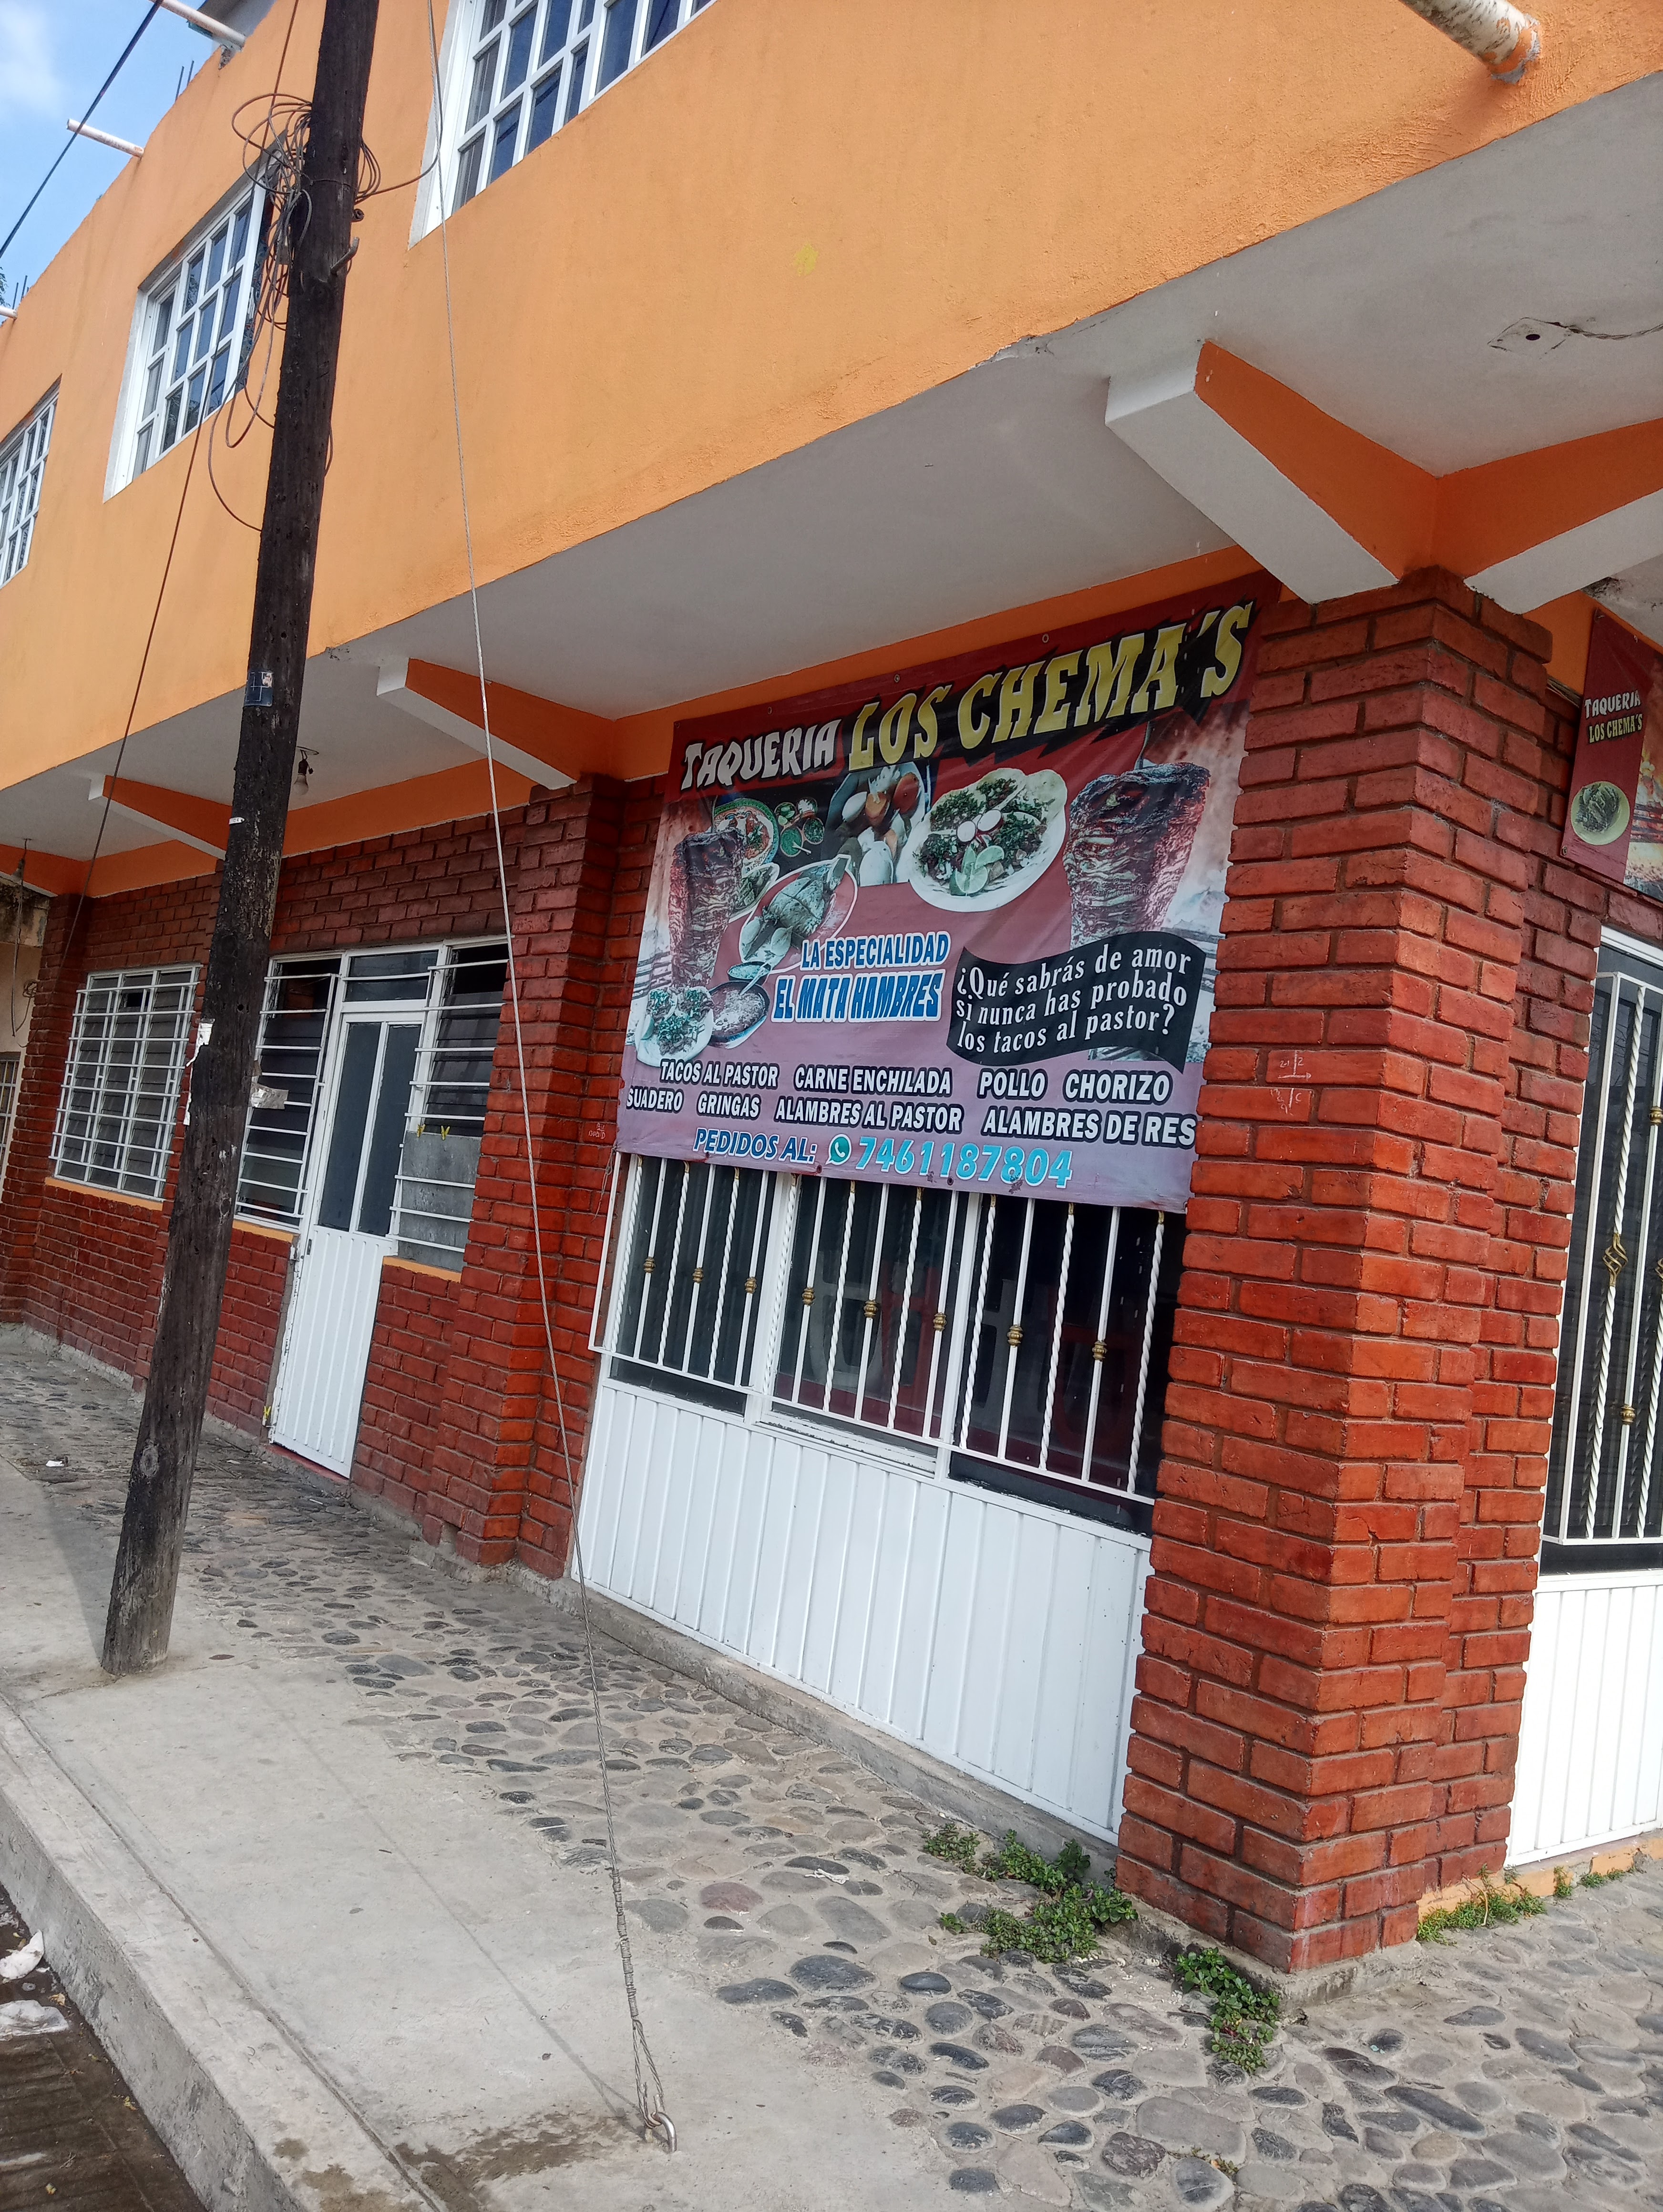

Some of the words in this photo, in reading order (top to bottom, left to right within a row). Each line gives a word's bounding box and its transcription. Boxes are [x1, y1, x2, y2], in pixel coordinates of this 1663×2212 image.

[1584, 690, 1641, 719] TAQUERIA
[680, 718, 842, 791] TAQUERIA
[848, 684, 953, 772] LOS
[1589, 723, 1605, 743] LOS
[801, 939, 821, 971] LA
[825, 932, 949, 970] ESPECIALIDAD
[957, 966, 1007, 999] ¿Qué
[1015, 955, 1085, 995] sabrás
[1095, 943, 1121, 974] de
[1131, 947, 1191, 975] amor
[771, 975, 795, 1022] EL
[797, 974, 848, 1022] MATA
[849, 970, 945, 1021] HAMBRES
[956, 995, 973, 1021] si
[977, 1003, 1036, 1025] nunca
[1044, 989, 1081, 1017] has
[1091, 971, 1187, 1010] probado
[957, 1022, 985, 1053] los
[994, 1027, 1047, 1054] tacos
[1056, 1010, 1077, 1041] al
[1085, 1003, 1175, 1041] pastor?
[661, 1061, 700, 1083] TACOS
[703, 1065, 720, 1084] AL
[724, 1064, 778, 1087] PASTOR
[795, 1067, 847, 1090] CARNE
[853, 1069, 951, 1094] ENCHILADA
[979, 1072, 1047, 1097] POLLO
[1065, 1073, 1170, 1102] CHORIZO
[627, 1088, 683, 1111] SUADERO
[698, 1094, 760, 1117] GRINGAS
[776, 1099, 861, 1125] ALAMBRES
[863, 1104, 886, 1126] AL
[891, 1105, 962, 1131] PASTOR
[983, 1109, 1099, 1139] ALAMBRES
[1106, 1114, 1137, 1141] DE
[1144, 1116, 1196, 1145] RES
[693, 1128, 778, 1160] PEDIDOS
[779, 1137, 818, 1164] AL:
[855, 1136, 1073, 1188] 7461187804
